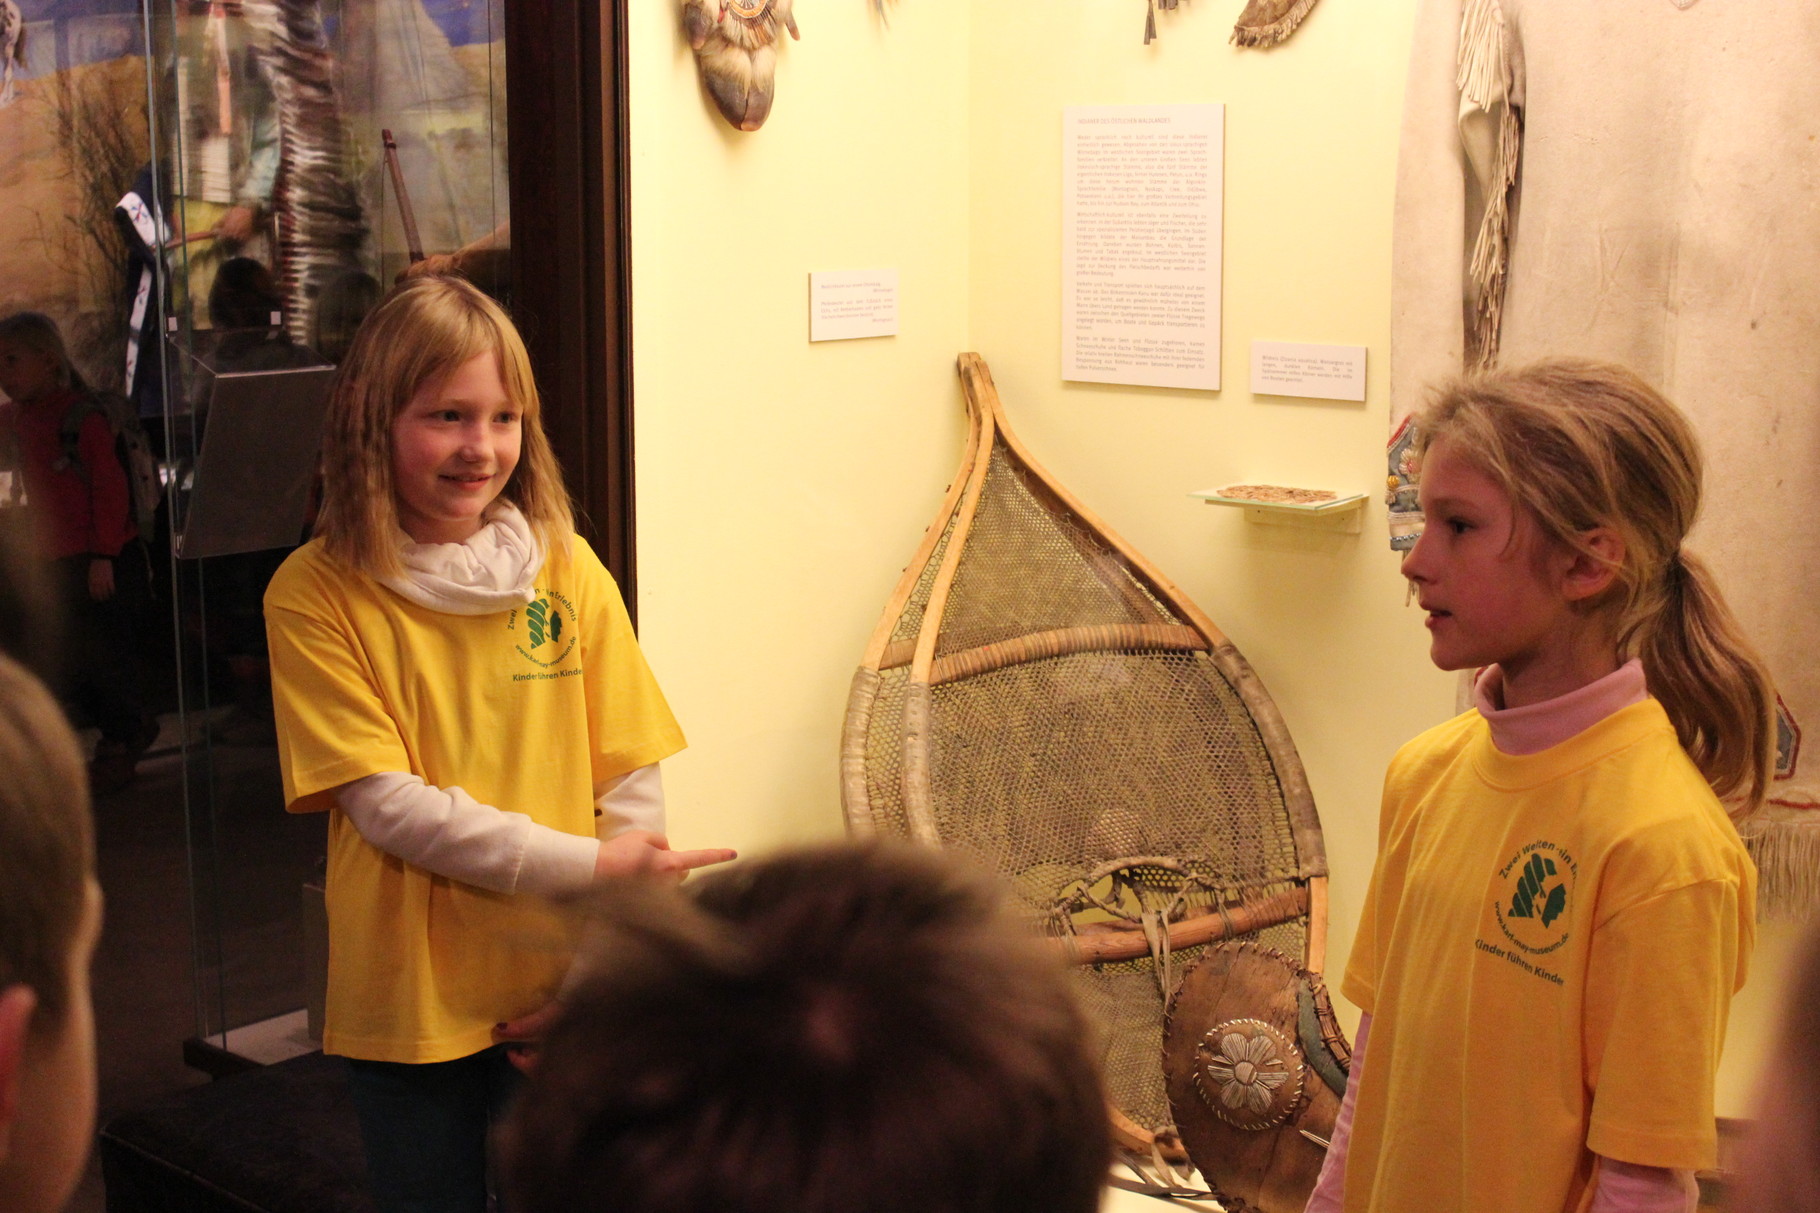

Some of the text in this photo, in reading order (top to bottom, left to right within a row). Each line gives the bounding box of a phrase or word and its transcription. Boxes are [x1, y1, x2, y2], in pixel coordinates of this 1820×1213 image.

[507, 609, 517, 630] Zwei
[560, 667, 582, 678] Kinde
[1499, 851, 1521, 879] Zwei
[1522, 840, 1555, 855] Welten
[1507, 951, 1533, 974] führen
[1534, 966, 1564, 986] Kinder
